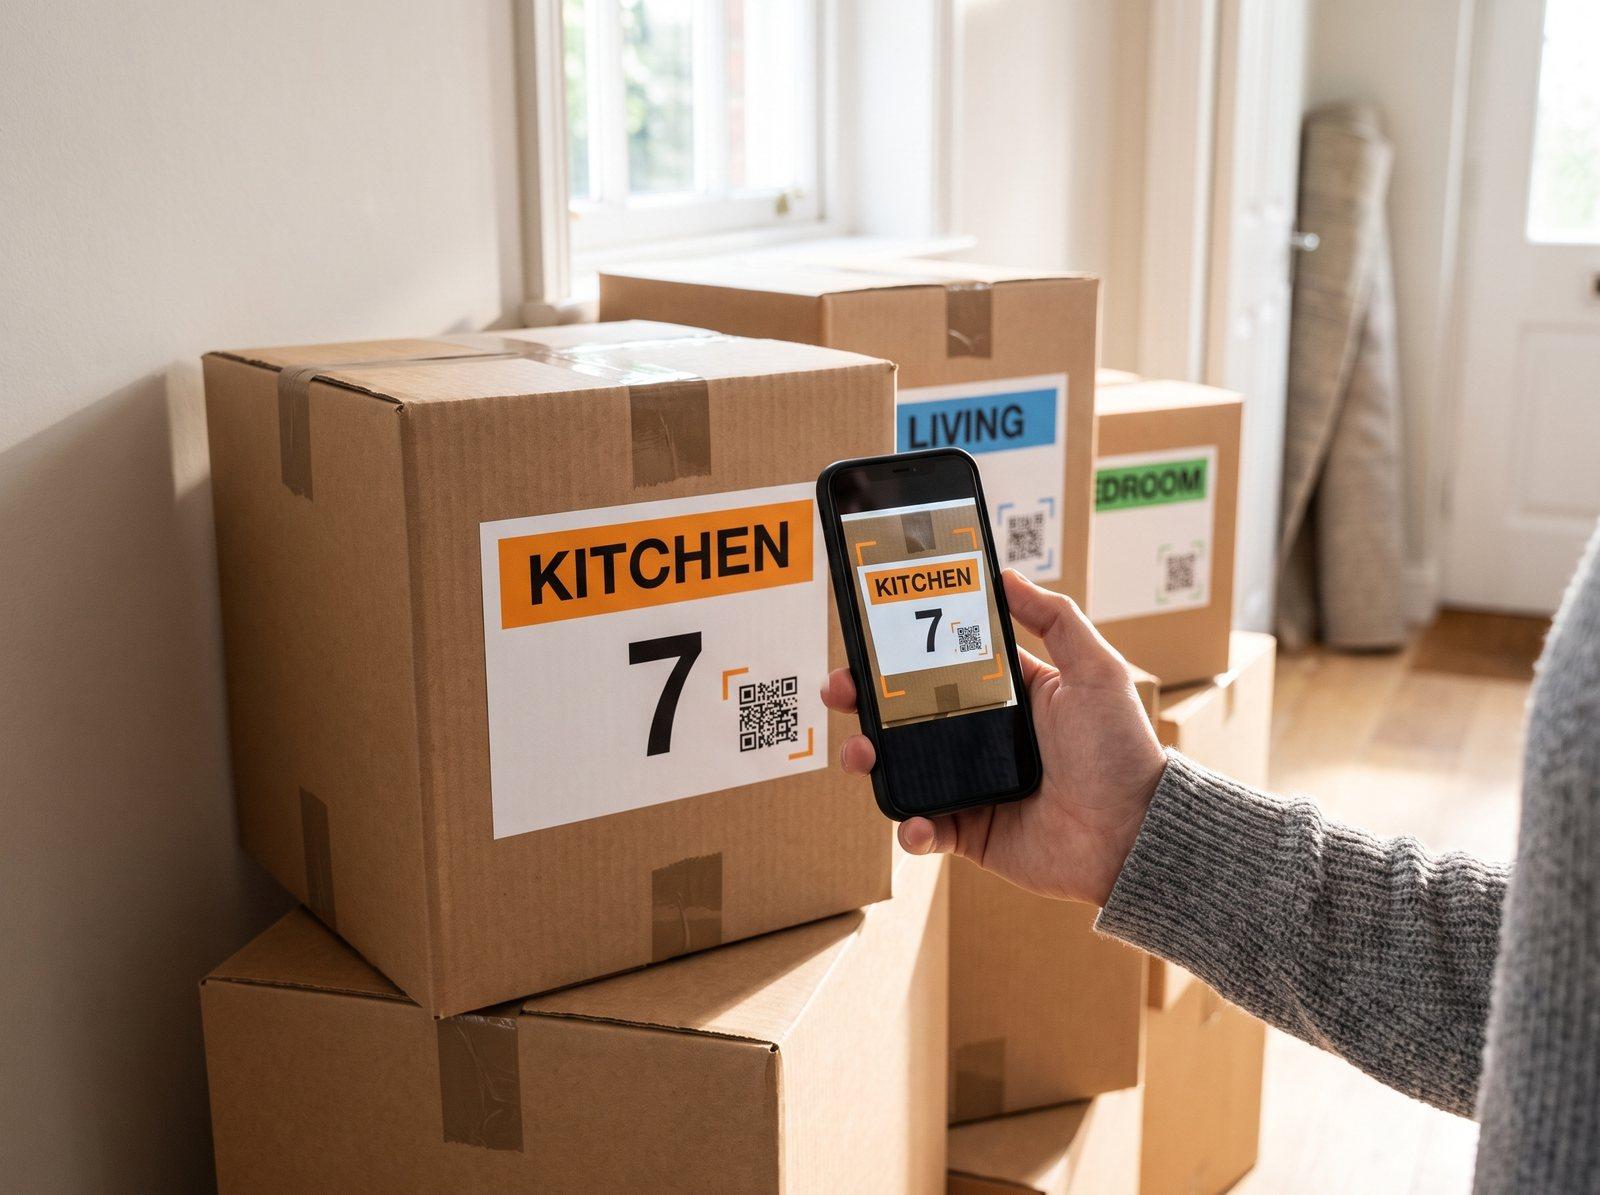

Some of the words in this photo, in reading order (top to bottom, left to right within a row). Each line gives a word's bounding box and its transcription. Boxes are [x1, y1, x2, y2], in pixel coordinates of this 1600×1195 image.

[909, 404, 1024, 449] LIVING
[529, 521, 789, 606] KITCHEN
[875, 566, 971, 597] KITCHEN
[915, 608, 943, 653] 7
[628, 631, 703, 757] 7
